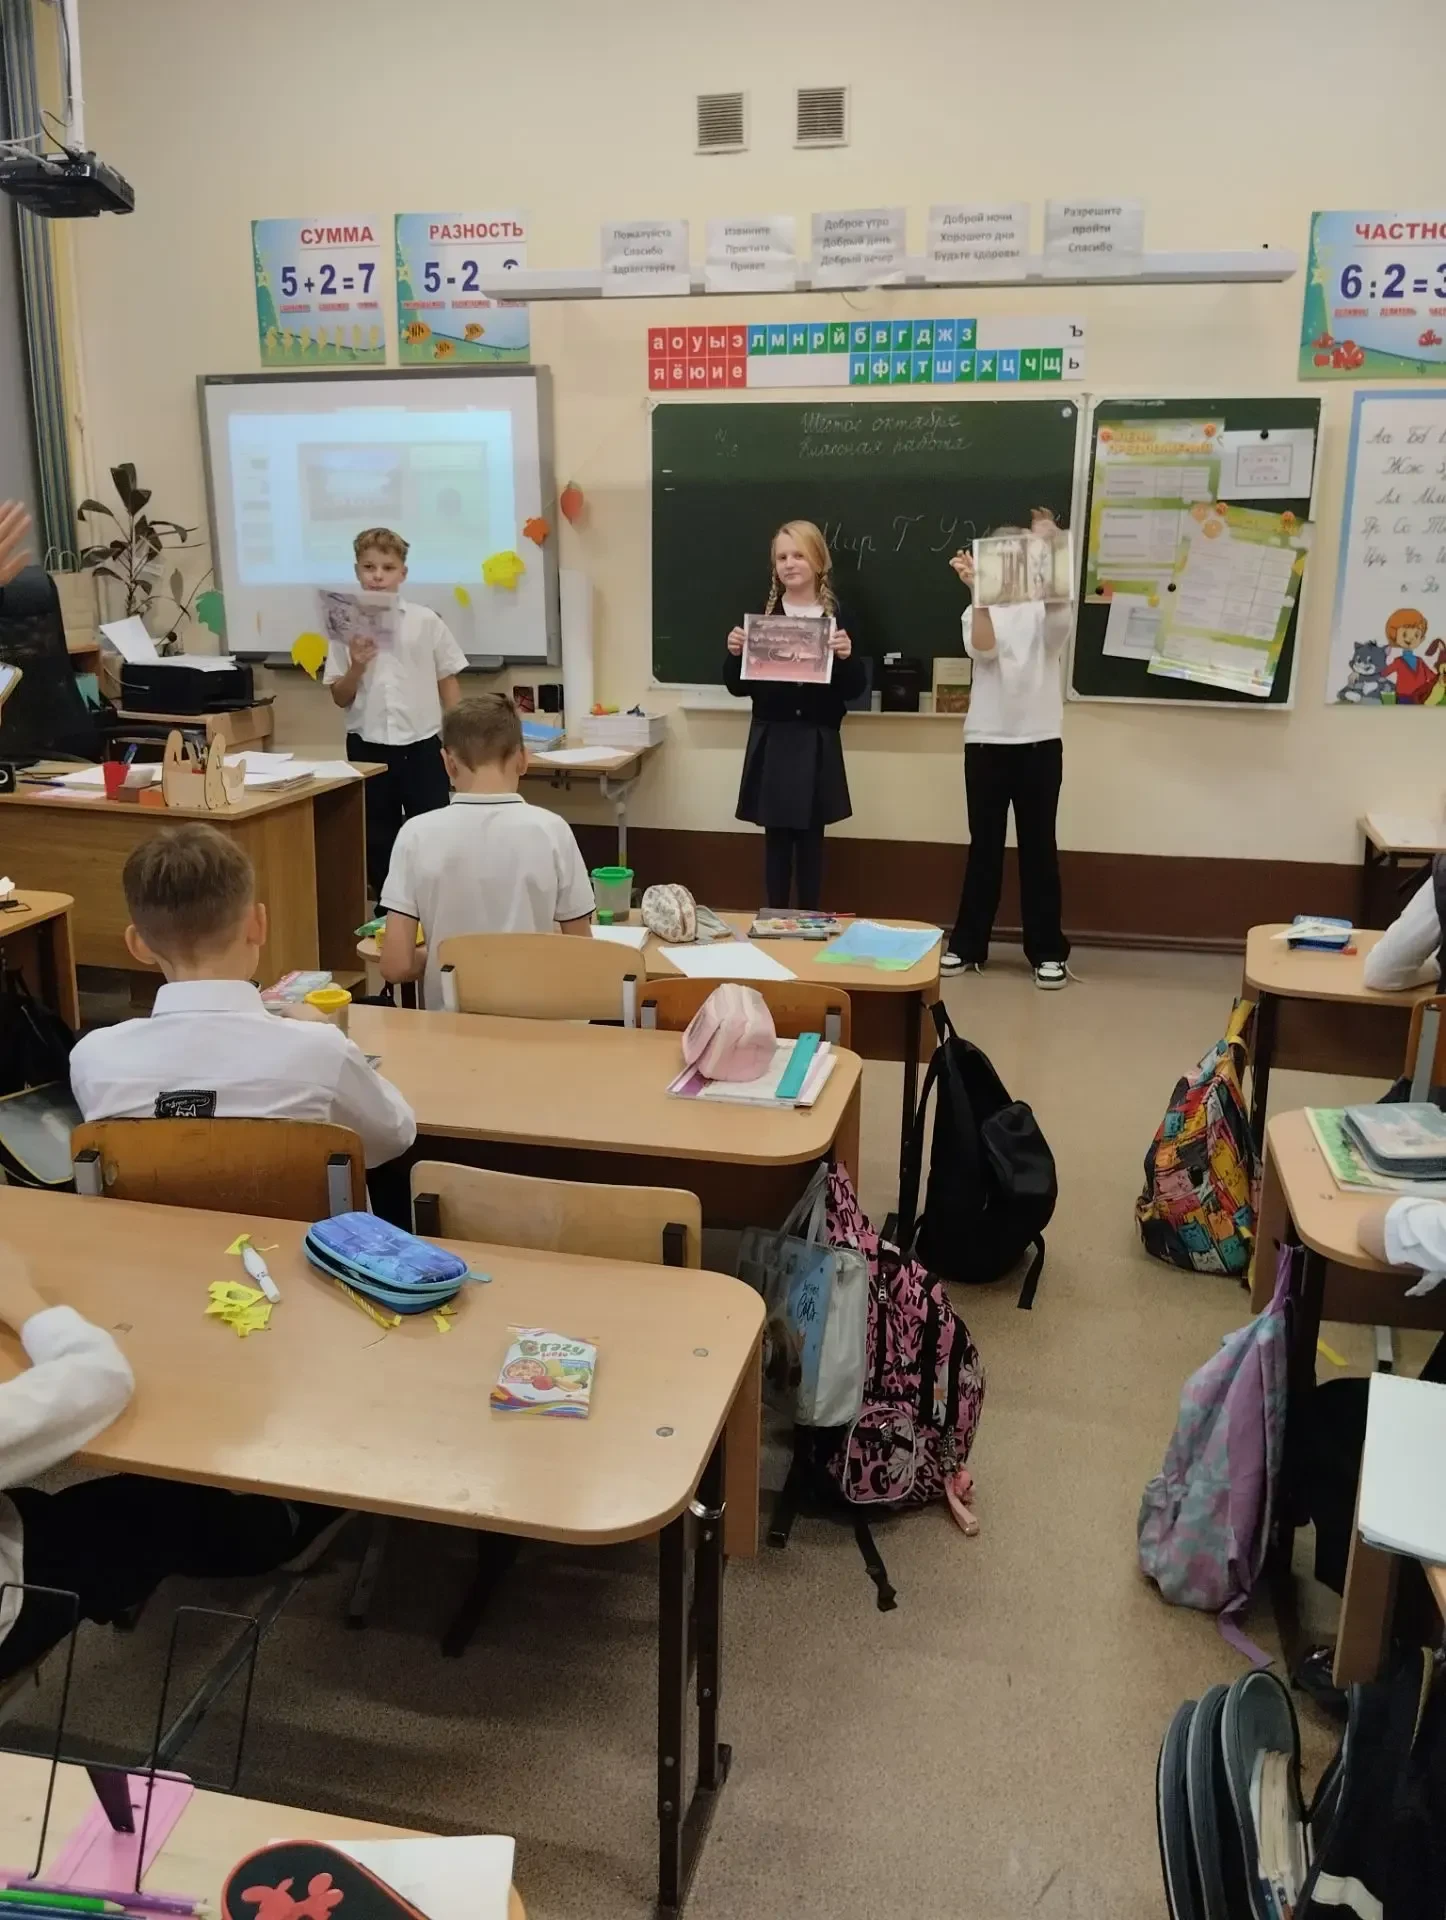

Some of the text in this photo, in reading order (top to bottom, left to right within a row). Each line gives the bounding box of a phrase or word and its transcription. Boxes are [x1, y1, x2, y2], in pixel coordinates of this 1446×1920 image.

[1063, 206, 1122, 218] Разрешите
[824, 218, 889, 233] Доброе утро
[943, 213, 1013, 226] Доброй ночи
[301, 226, 373, 245] СУММА
[430, 222, 523, 240] РАЗНОСТЬ
[613, 228, 672, 241] Пожалуйста
[724, 226, 771, 237] Извините
[1072, 223, 1112, 236] пройти
[822, 234, 891, 250] Добрый день
[940, 230, 1015, 243] Хорошего дня
[624, 246, 664, 257] Спасибо
[725, 243, 770, 256] Простите
[1068, 242, 1113, 254] Спасибо
[820, 253, 862, 267] Добрый
[934, 248, 1020, 262] Будьте здоровы
[612, 262, 676, 275] Здравствуйте
[730, 261, 766, 273] Привет
